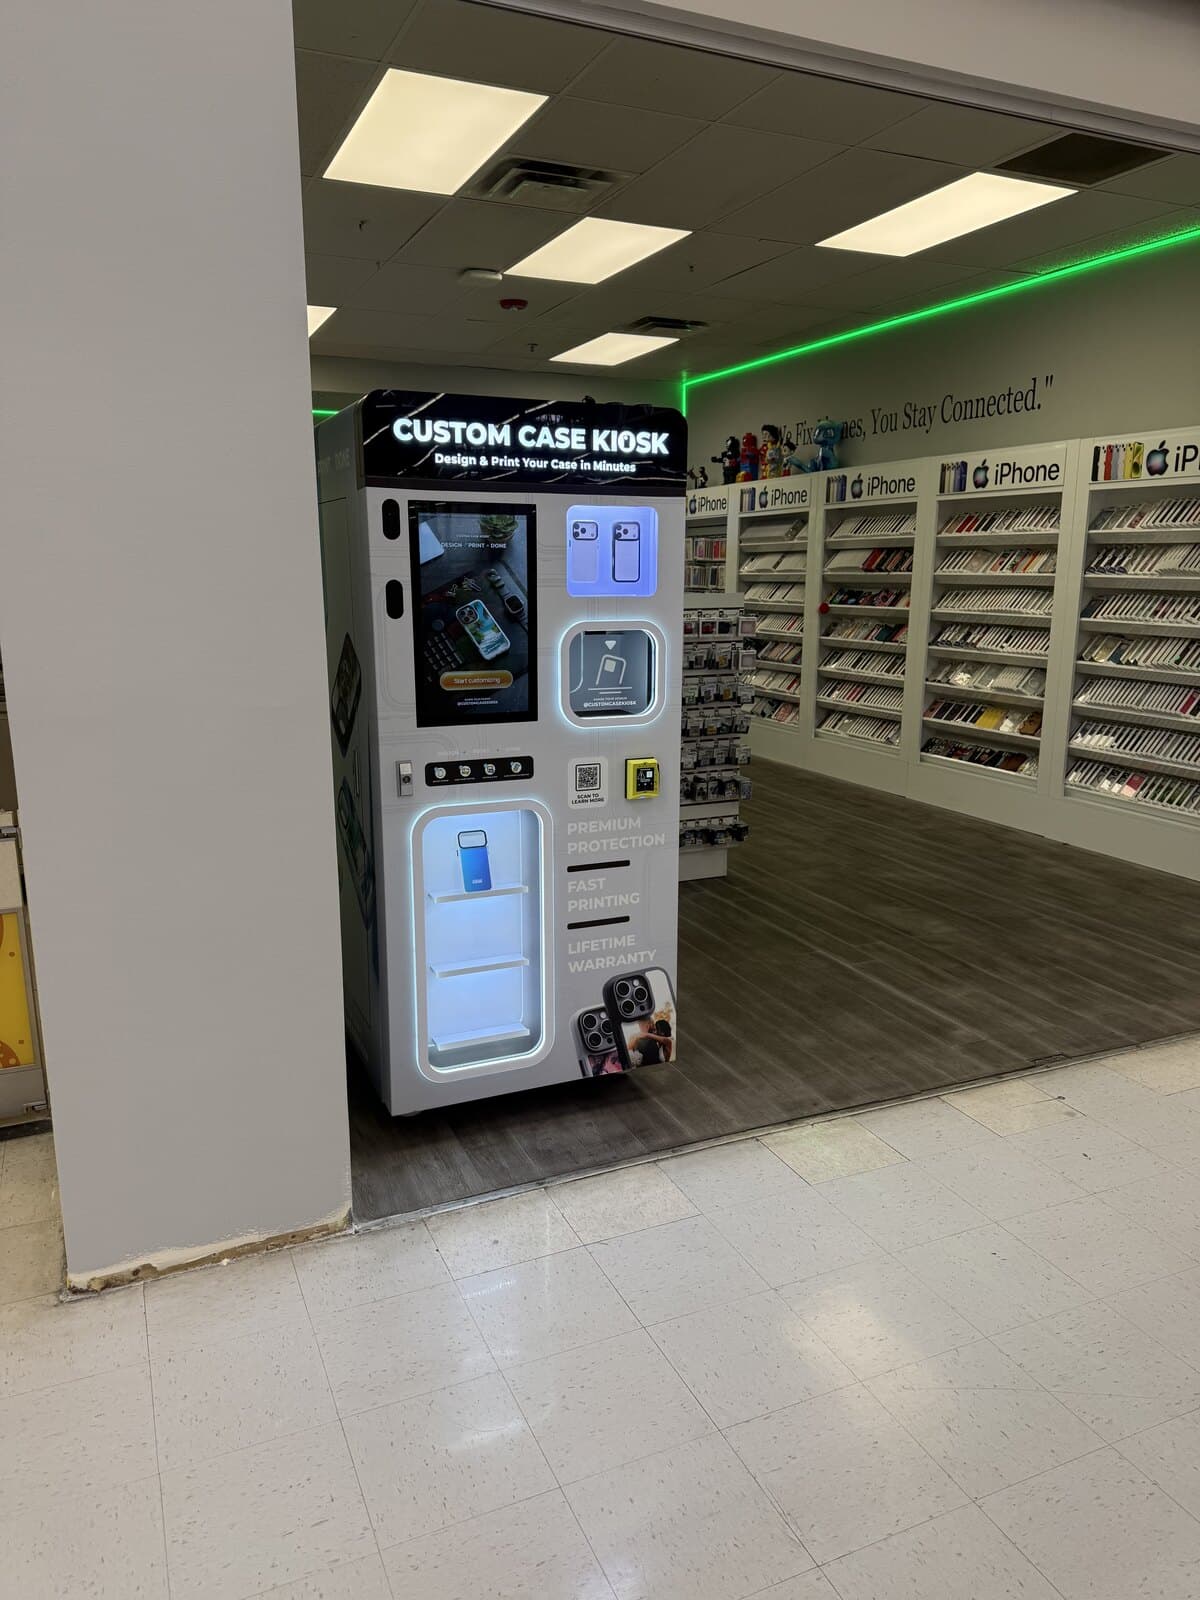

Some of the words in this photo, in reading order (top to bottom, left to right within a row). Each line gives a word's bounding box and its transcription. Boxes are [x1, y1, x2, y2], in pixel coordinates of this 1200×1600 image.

[796, 420, 813, 446] Fix
[871, 408, 898, 435] You
[902, 401, 937, 434] Stay
[392, 418, 511, 446] CUSTOM
[518, 424, 586, 450] CASE
[592, 428, 670, 454] KIOSK
[434, 453, 477, 467] Design
[479, 456, 489, 466] &
[491, 455, 520, 468] Print
[522, 457, 548, 469] Your
[550, 459, 577, 470] Case
[580, 460, 591, 470] in
[593, 460, 637, 473] Minutes
[1174, 445, 1200, 472] iP
[994, 461, 1060, 486] iPhone
[867, 476, 916, 496] iPhone
[697, 495, 727, 512] iPhone
[770, 488, 808, 506] iPhone
[567, 816, 641, 836] PREMIUM
[567, 833, 666, 854] PROTECTION
[567, 877, 606, 893] FAST
[567, 892, 640, 912] PRINTING
[567, 934, 636, 955] LIFETIME
[567, 949, 657, 974] WARRANTY
